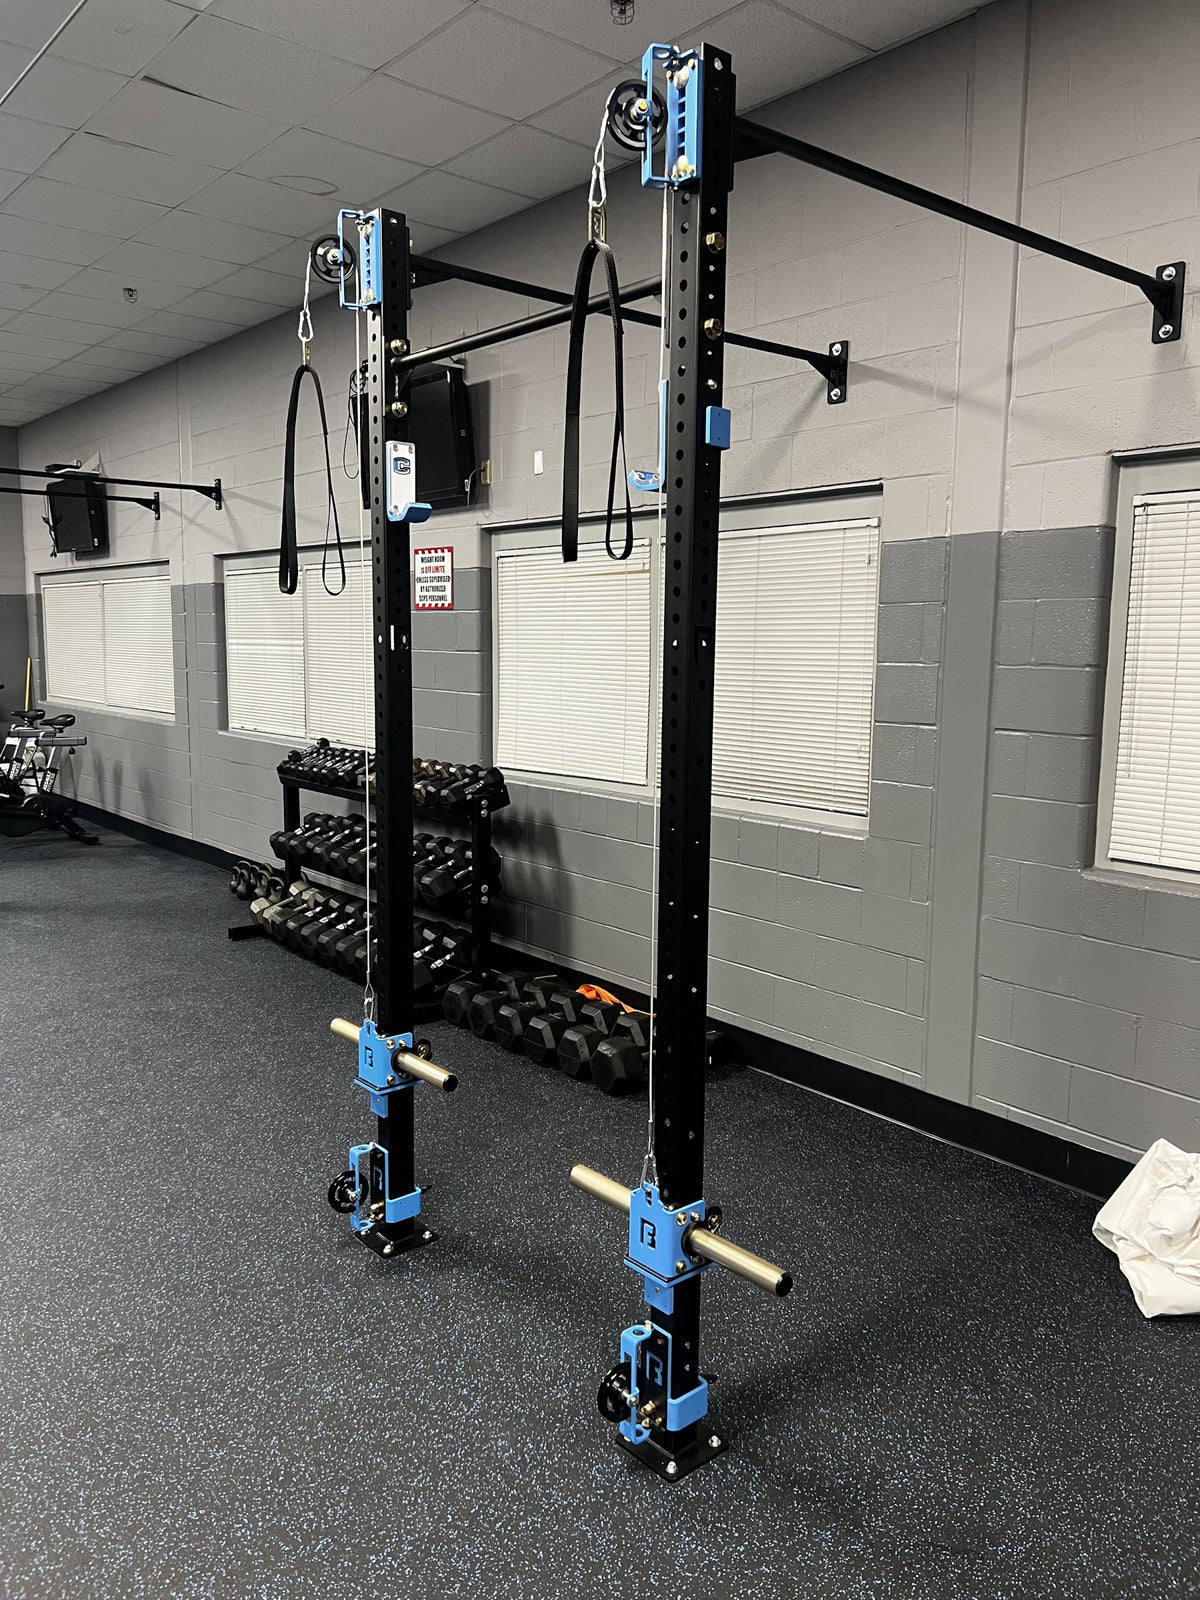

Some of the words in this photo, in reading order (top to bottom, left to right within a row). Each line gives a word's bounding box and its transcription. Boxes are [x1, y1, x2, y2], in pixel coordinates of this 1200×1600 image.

[434, 555, 445, 563] ROOM
[421, 566, 425, 574] IS
[432, 565, 445, 574] LIMITS
[429, 575, 450, 583] SUPERVISED
